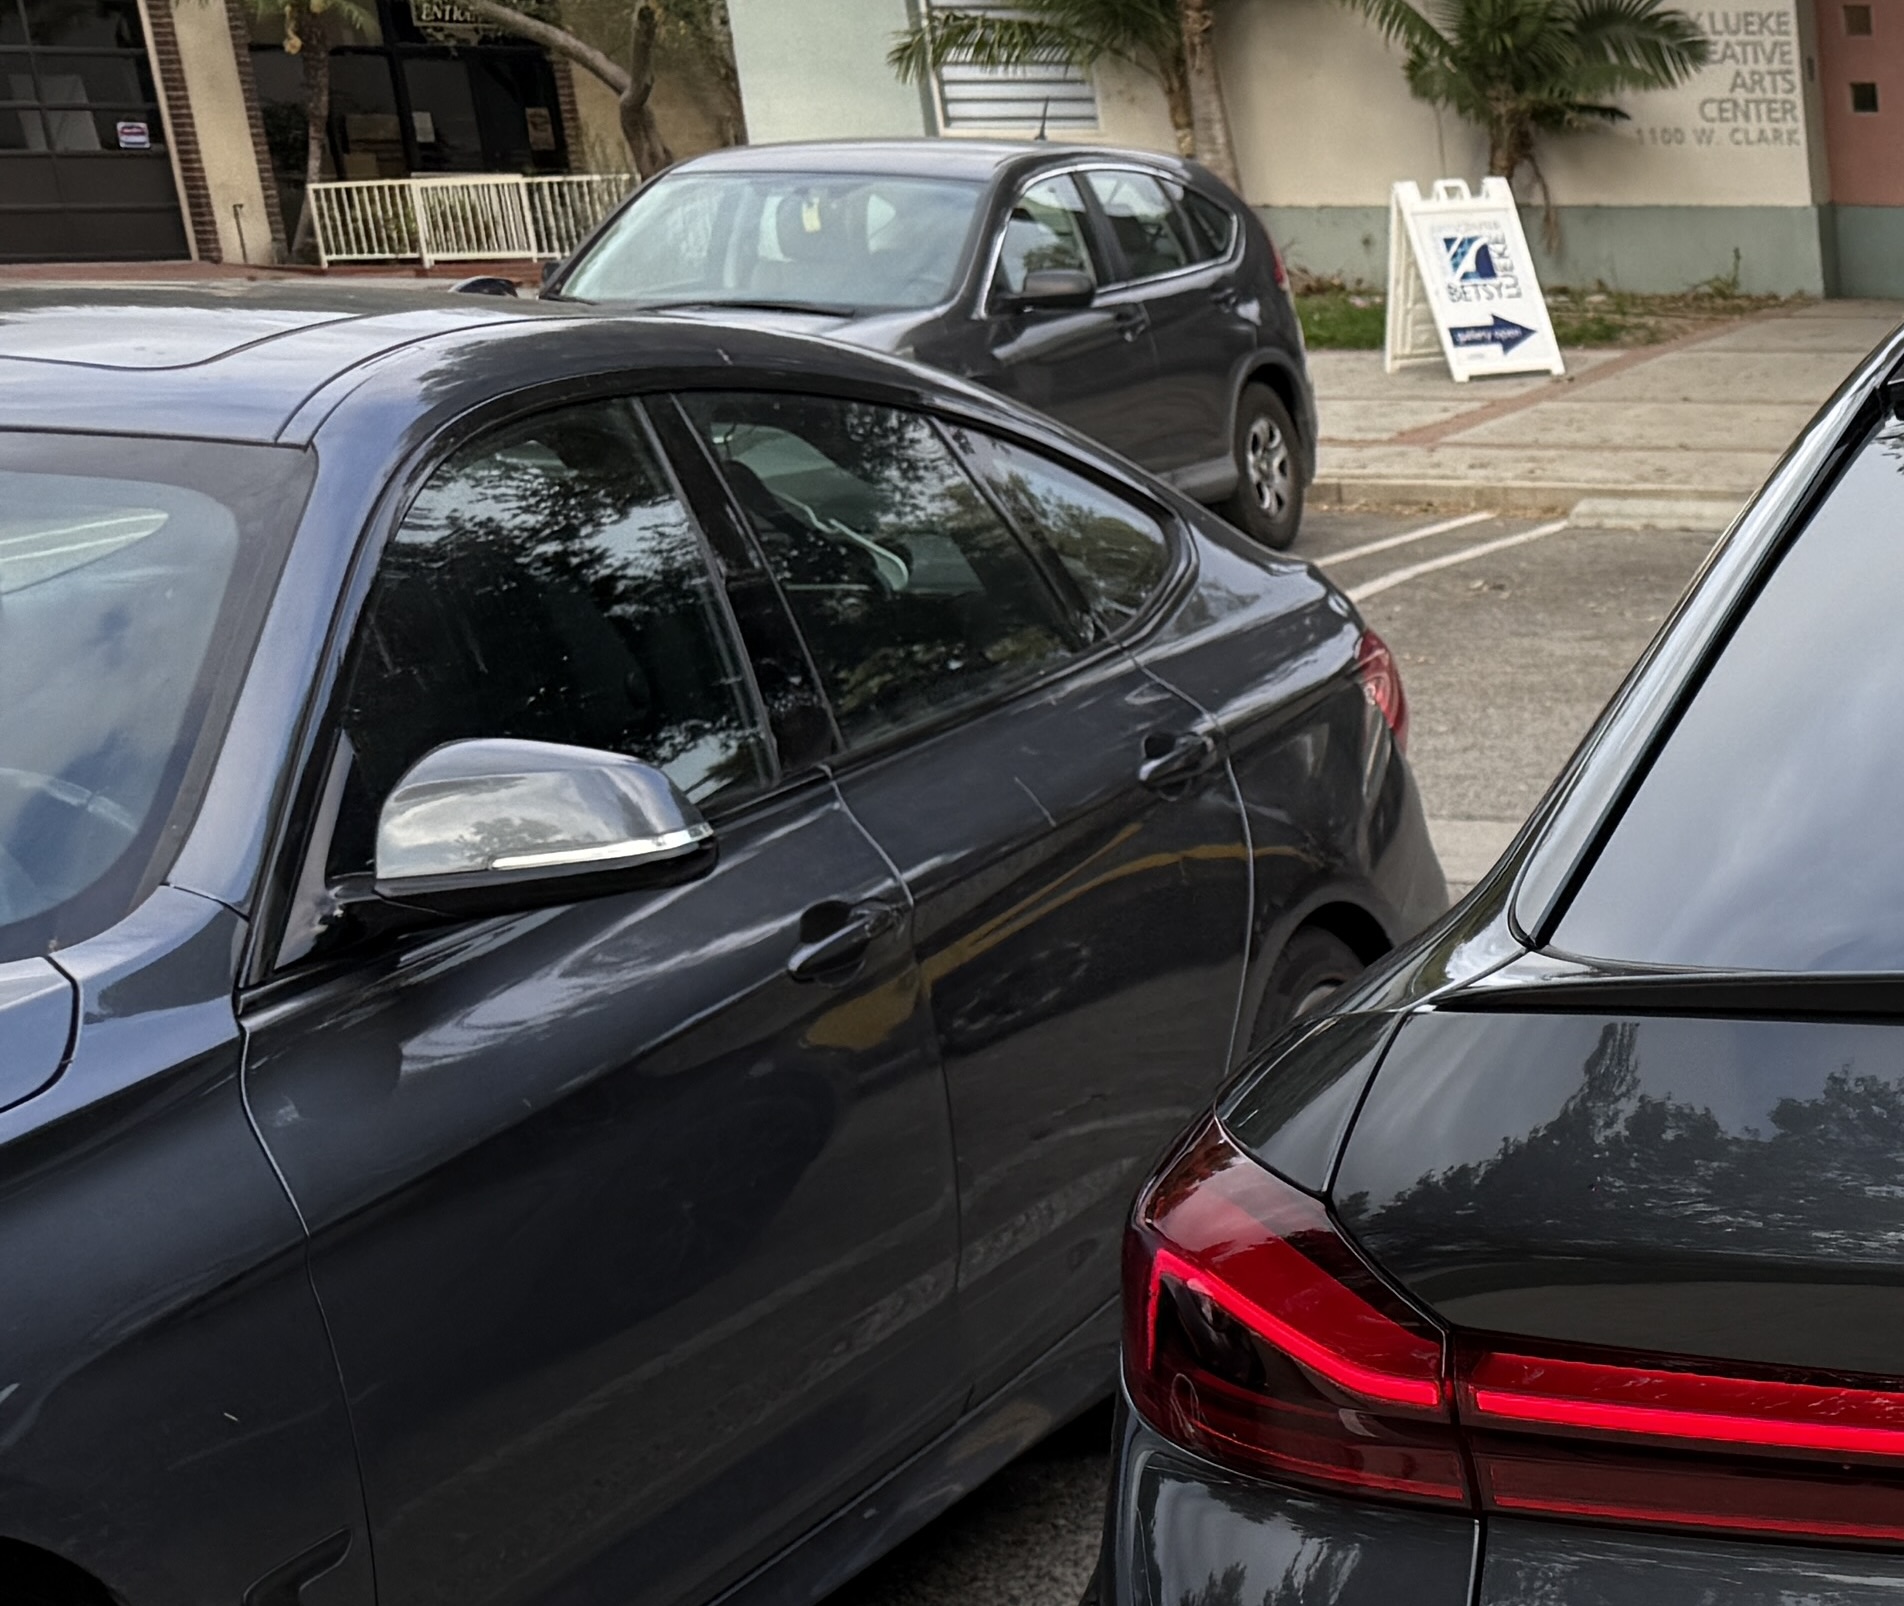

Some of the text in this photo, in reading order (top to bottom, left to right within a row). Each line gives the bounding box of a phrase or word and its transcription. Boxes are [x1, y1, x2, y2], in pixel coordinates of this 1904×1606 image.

[1708, 11, 1791, 36] LUEKE
[1707, 40, 1793, 65] EATIVE
[1729, 69, 1797, 94] ARTS
[1699, 98, 1799, 123] CENTER
[1636, 127, 1686, 145] 1100
[1729, 127, 1802, 146] CLARK
[1447, 282, 1503, 303] BETSY
